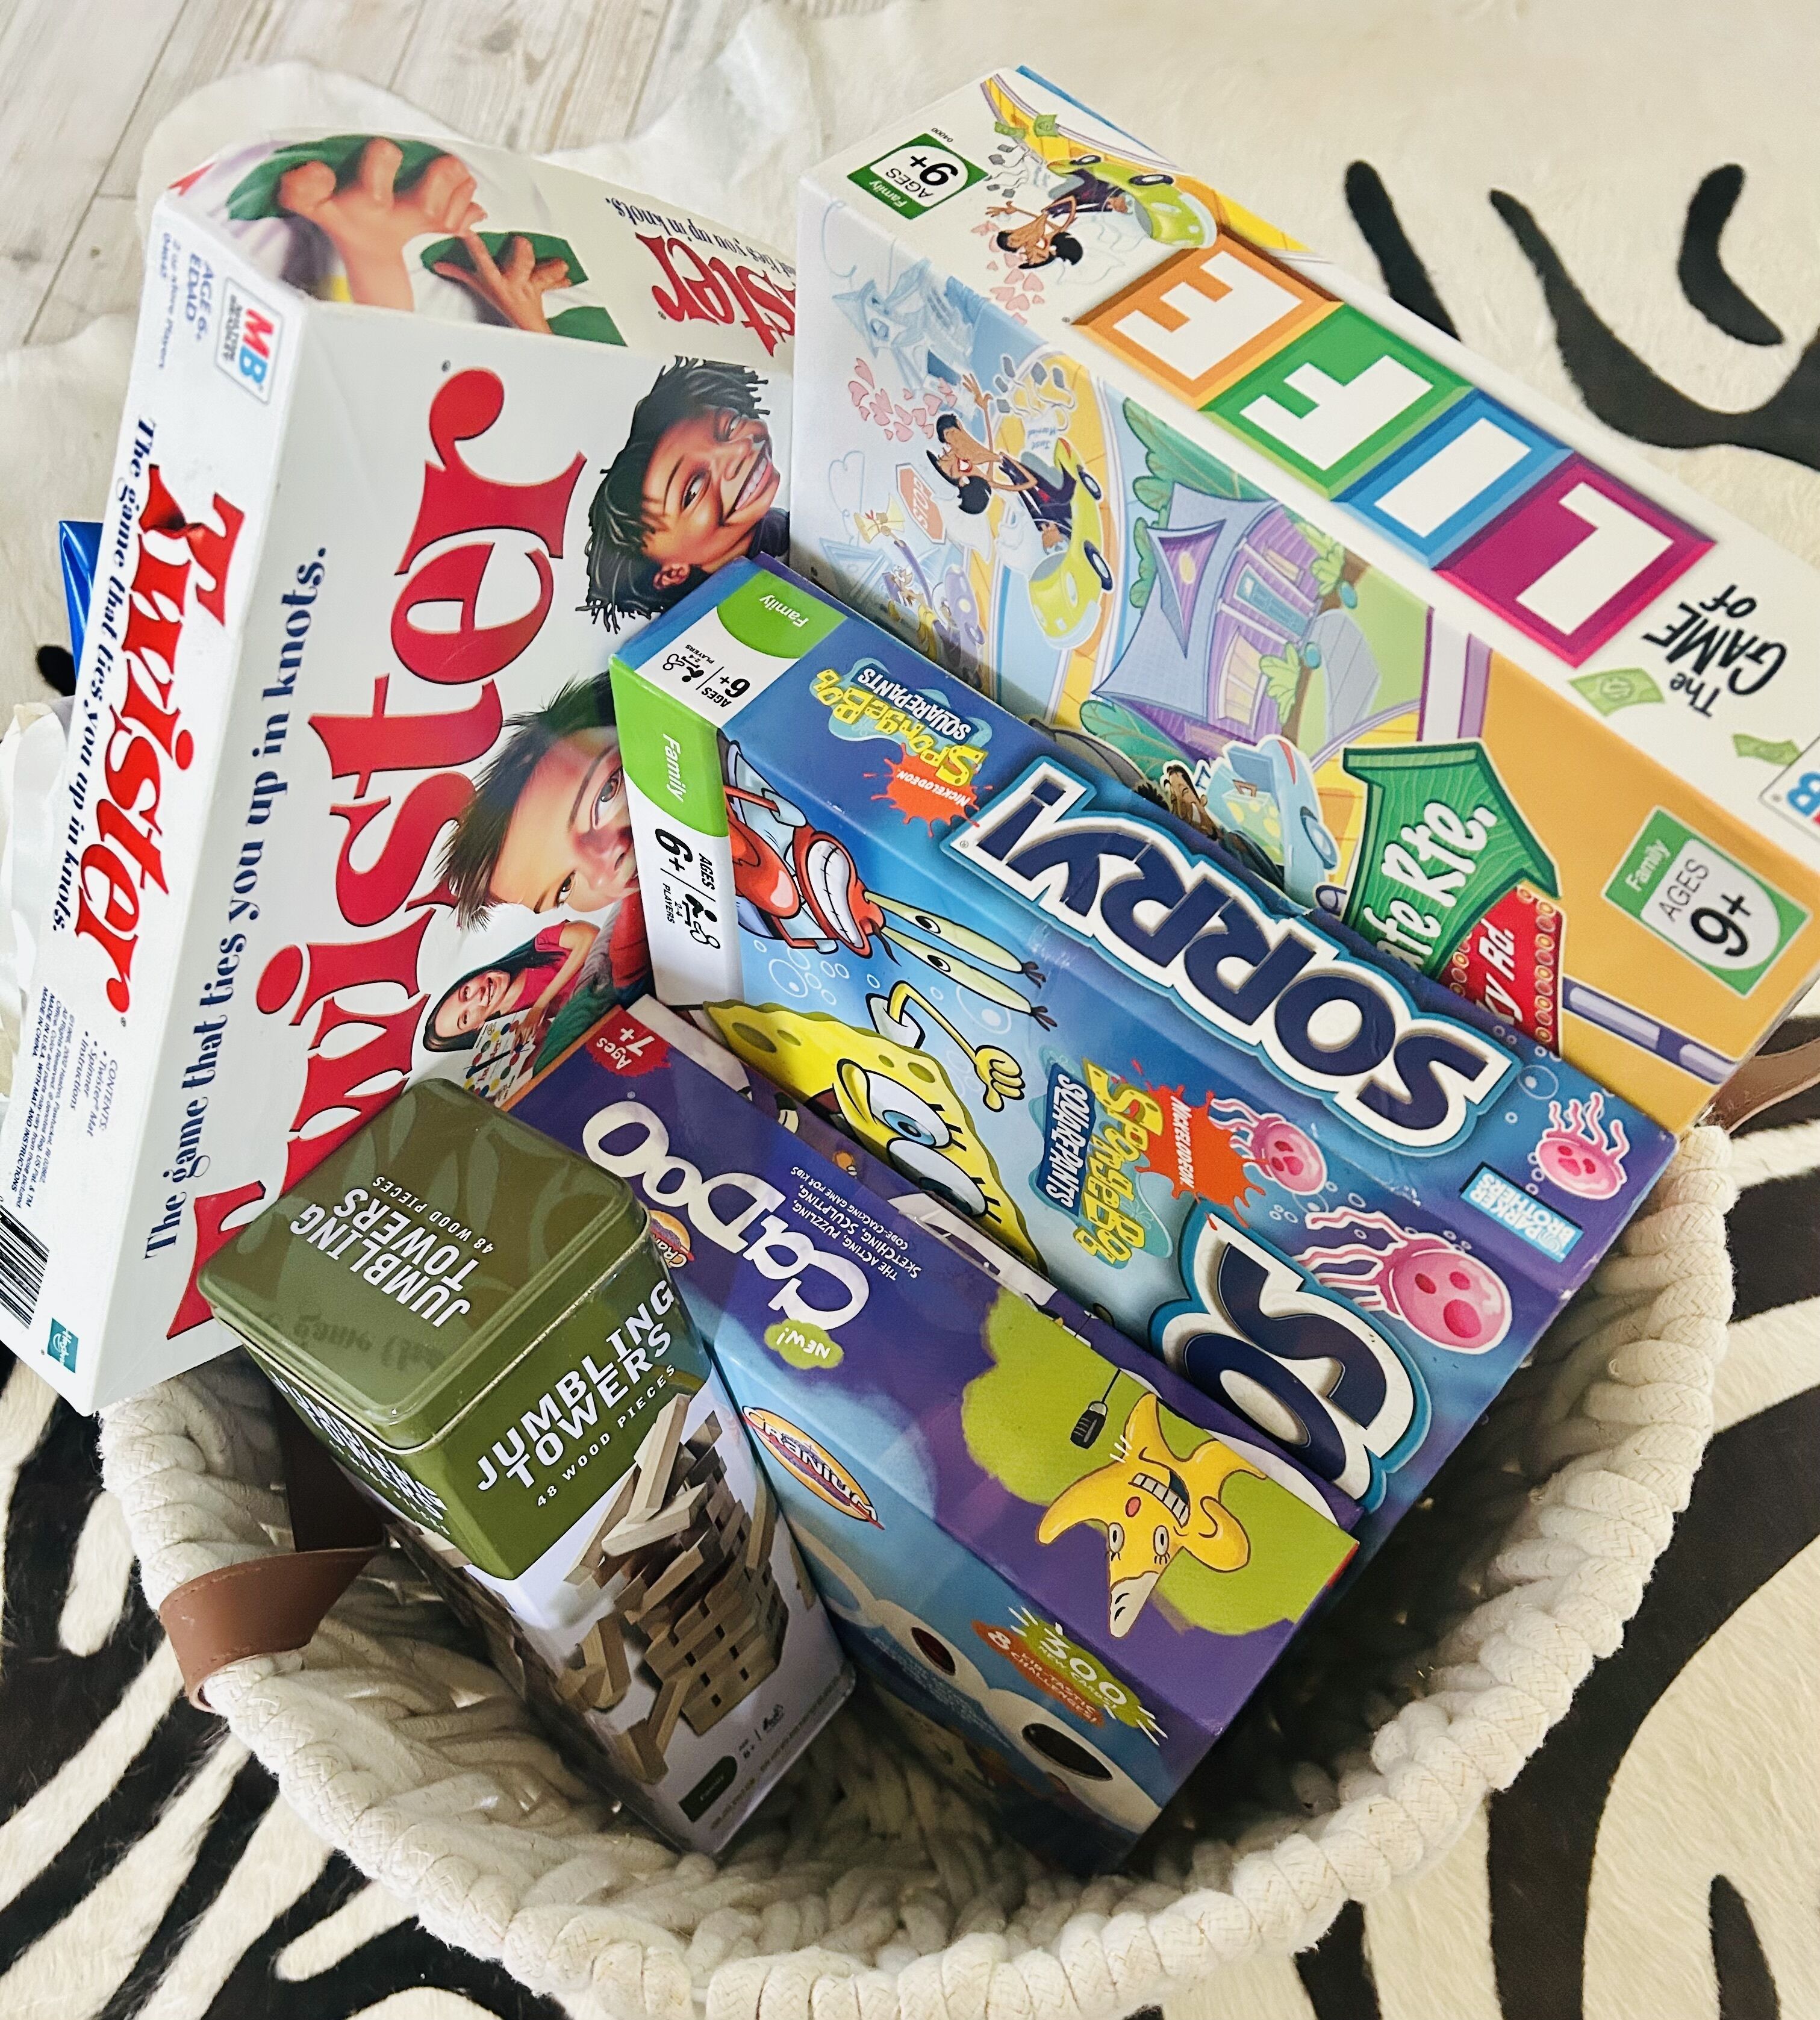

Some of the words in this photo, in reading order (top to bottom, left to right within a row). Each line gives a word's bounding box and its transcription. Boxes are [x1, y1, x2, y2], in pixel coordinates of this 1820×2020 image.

[931, 127, 954, 143] 04000
[868, 180, 908, 208] Family
[885, 167, 934, 198] AGES
[910, 155, 959, 185] 9+
[605, 197, 672, 236] knots.
[666, 217, 693, 242] in
[687, 218, 714, 246] up
[712, 233, 747, 256] you
[185, 254, 201, 322] EDAD
[200, 261, 214, 314] AGE
[635, 232, 796, 358] ster
[239, 308, 274, 384] MB
[131, 417, 156, 479] The
[1112, 251, 1674, 635] LIFE
[113, 477, 139, 569] game
[913, 476, 928, 529] STOP
[98, 575, 126, 647] that
[262, 546, 328, 702] knots.
[759, 594, 809, 628] Family
[89, 643, 115, 703] ties
[685, 644, 715, 664] PLAYERS
[1641, 602, 1787, 696] GAME
[701, 686, 732, 708] AGES
[719, 676, 750, 698] 6+
[857, 668, 971, 740] SQUAREPANTS
[1669, 672, 1721, 719] The
[75, 463, 246, 1013] Twister
[81, 699, 99, 767] you
[252, 712, 290, 758] in
[69, 773, 88, 809] up
[662, 732, 684, 803] Family
[896, 770, 971, 807] NICKELODEON
[245, 771, 288, 828] up
[1787, 771, 1820, 828] B
[66, 817, 86, 844] in
[655, 828, 693, 873] 6+
[1381, 802, 1497, 908] Rte.
[53, 850, 80, 932] knots.
[228, 839, 264, 923] you
[699, 853, 715, 890] AGES
[1625, 840, 1671, 893] Family
[1659, 858, 1710, 923] AGES
[662, 882, 675, 924] PLAYERS
[1689, 891, 1753, 959] 9+
[200, 933, 247, 1008] ties
[950, 762, 1513, 1147] SORRY!
[1479, 918, 1515, 981] Rd.
[37, 1015, 43, 1027] IN
[44, 1021, 49, 1033] IN
[46, 992, 55, 1022] MADE
[182, 1014, 228, 1089] that
[596, 1036, 632, 1071] Ages
[620, 1027, 656, 1058] 7+
[40, 1070, 49, 1094] parts
[70, 1039, 89, 1111] Instructions
[84, 1049, 98, 1097] Spinner
[100, 1059, 117, 1131] CONTENTS:
[26, 1106, 34, 1127] AND
[87, 1111, 98, 1136] Mat
[163, 1096, 210, 1182] game
[1046, 1073, 1090, 1208] SQUAREPANTS
[1170, 1095, 1195, 1189] NICKELODEON
[11, 1127, 30, 1192] INSTRUCTIONS
[23, 1151, 33, 1174] those
[790, 1166, 811, 1182] KIDS
[808, 1178, 827, 1192] FOR
[25, 1193, 33, 1207] TM
[372, 1176, 428, 1213] PIECES
[792, 1199, 841, 1239] PUZZLING,
[798, 1184, 859, 1235] SCULPTING,
[824, 1189, 849, 1208] GAME
[1470, 1189, 1542, 1241] PARKER
[1482, 1173, 1575, 1247] BROTHERS
[142, 1191, 187, 1260] The
[332, 1188, 479, 1292] TOWERS
[429, 1211, 472, 1242] WOOD
[473, 1238, 494, 1253] 48
[842, 1235, 880, 1266] ACTING,
[847, 1208, 908, 1250] CODE-CRACKING
[290, 1203, 471, 1328] JUMBLING
[861, 1228, 922, 1279] SKETCHING,
[878, 1261, 899, 1281] THE
[776, 1327, 831, 1359] NEW!
[477, 1280, 675, 1491] JUMBLING
[506, 1323, 672, 1488] TOWERS
[537, 1485, 558, 1507] 48
[562, 1432, 610, 1481] WOOD
[617, 1364, 675, 1428] PIECES
[988, 1631, 1011, 1650] 8
[1011, 1651, 1097, 1722] CHALLENGES!
[1039, 1645, 1067, 1669] NEW
[1070, 1671, 1117, 1709] CARDS!
[1040, 1628, 1127, 1705] 300
